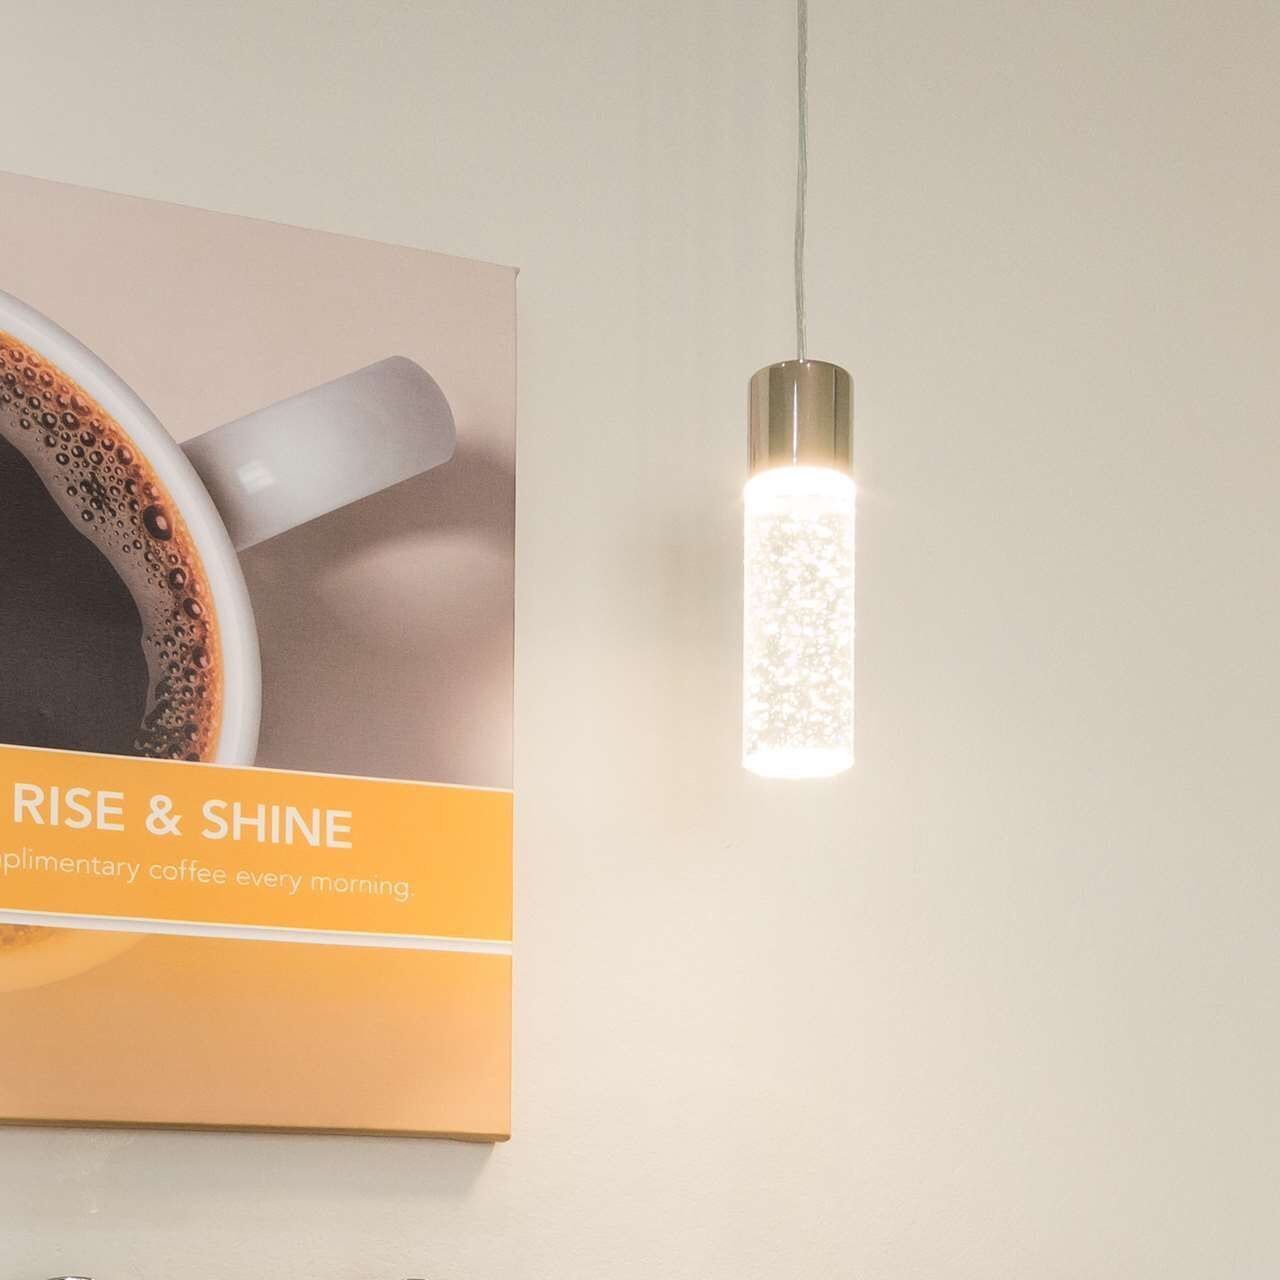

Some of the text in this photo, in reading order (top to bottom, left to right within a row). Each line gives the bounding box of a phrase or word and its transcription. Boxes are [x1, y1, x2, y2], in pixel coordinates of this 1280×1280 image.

[13, 782, 353, 849] RISE & SHINE
[149, 857, 226, 885] coffee
[235, 867, 304, 895] every
[311, 871, 416, 902] morning.
